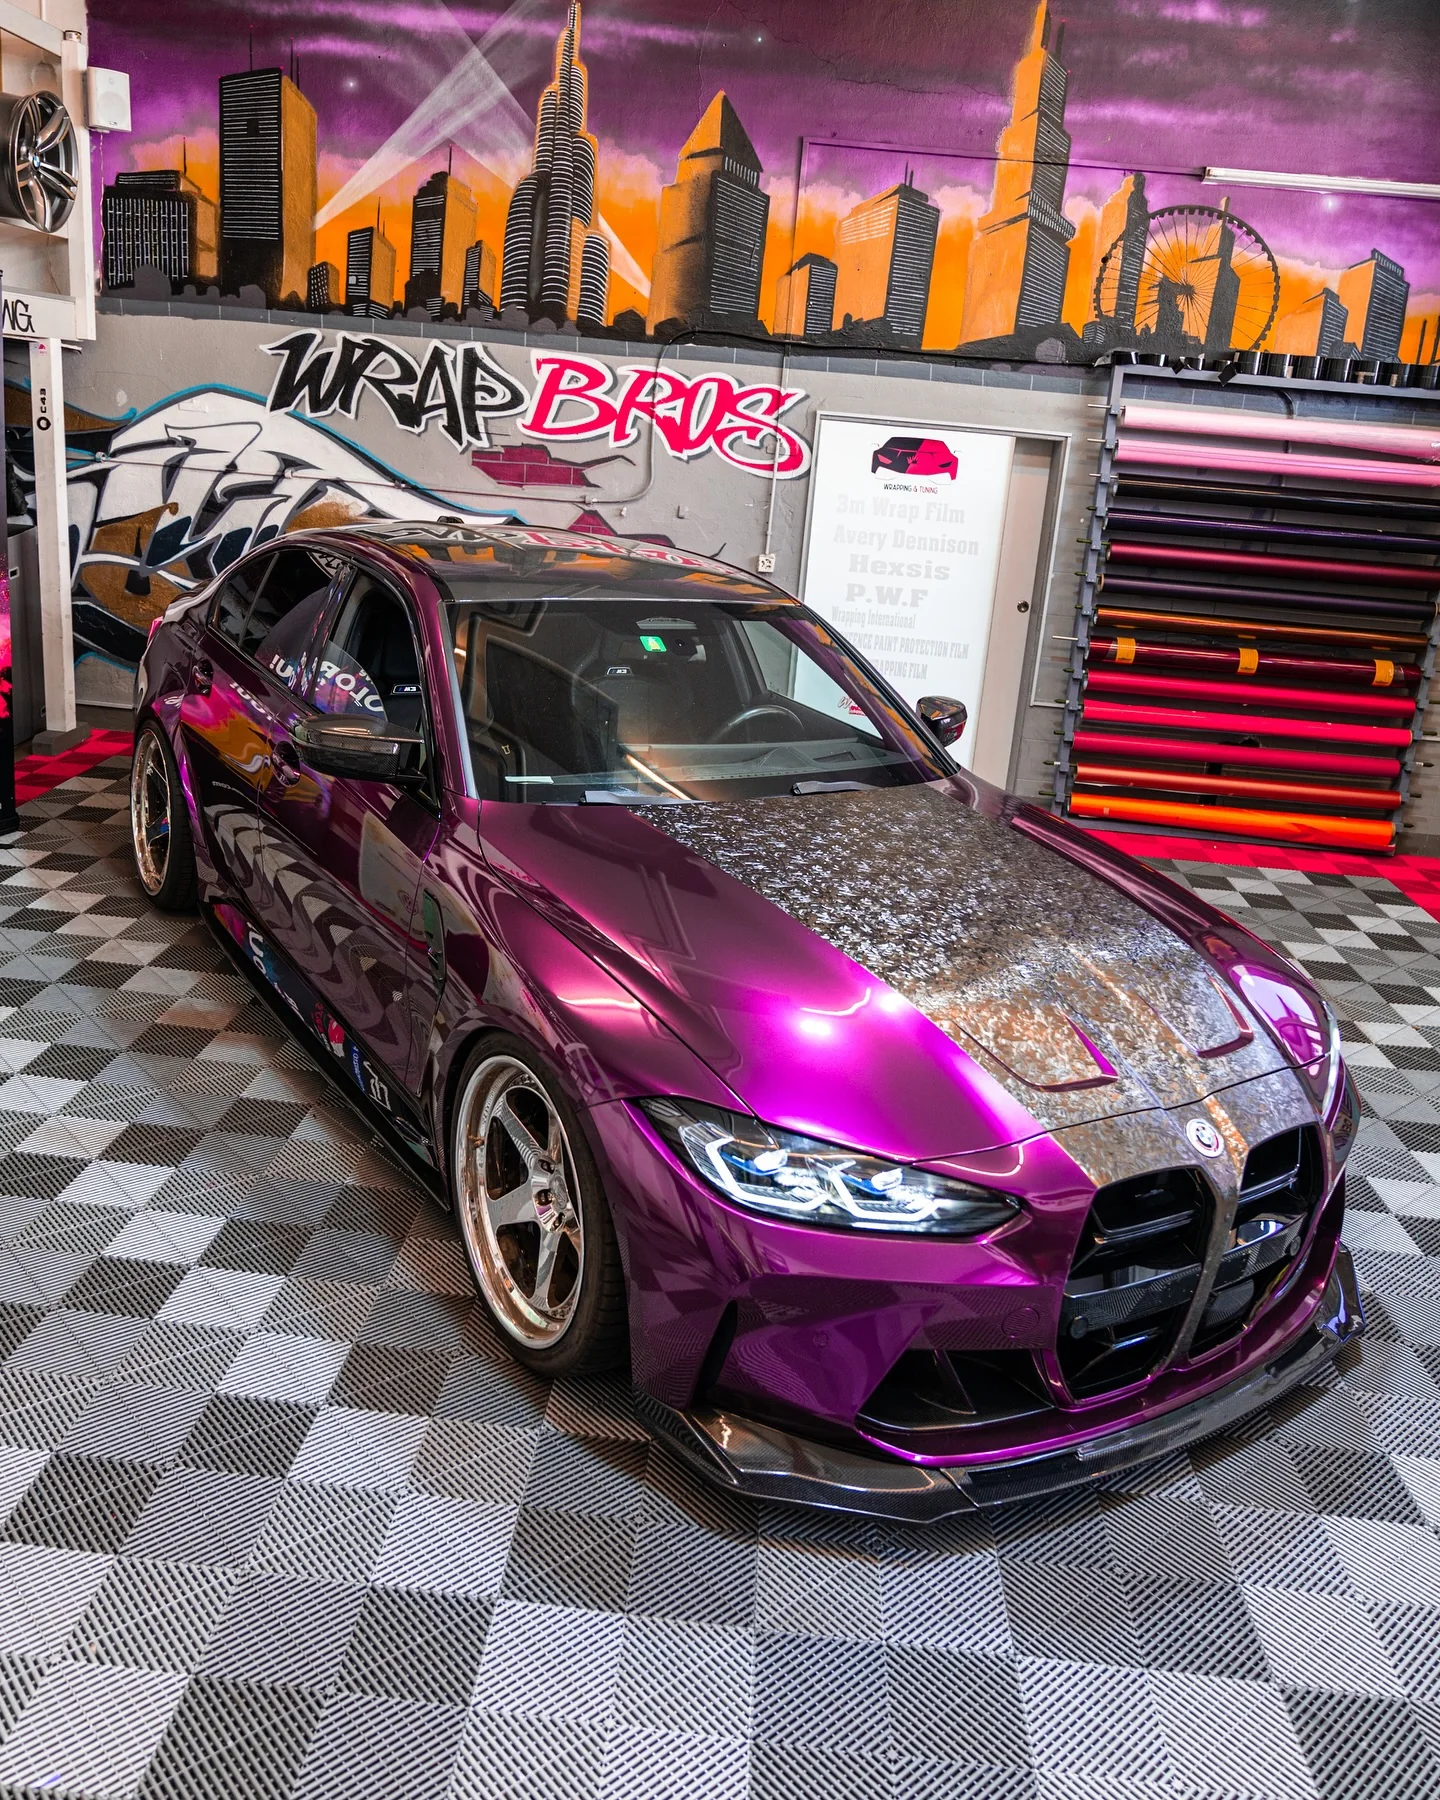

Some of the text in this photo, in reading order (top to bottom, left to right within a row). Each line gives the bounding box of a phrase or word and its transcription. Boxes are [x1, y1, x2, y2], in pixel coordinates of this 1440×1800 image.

[259, 329, 812, 479] WRAP BROS
[883, 483, 938, 494] WRAPPING & TUNING
[836, 493, 965, 524] 3m Wrap Film
[833, 523, 979, 556] Avery Dennison
[848, 553, 951, 580] Hexsis
[845, 583, 928, 608] P.W.F
[831, 605, 917, 630] Wrapping International
[873, 635, 899, 653] PAINT
[899, 637, 949, 658] PROTECTION
[949, 641, 970, 660] FILM
[908, 662, 928, 680] FILM
